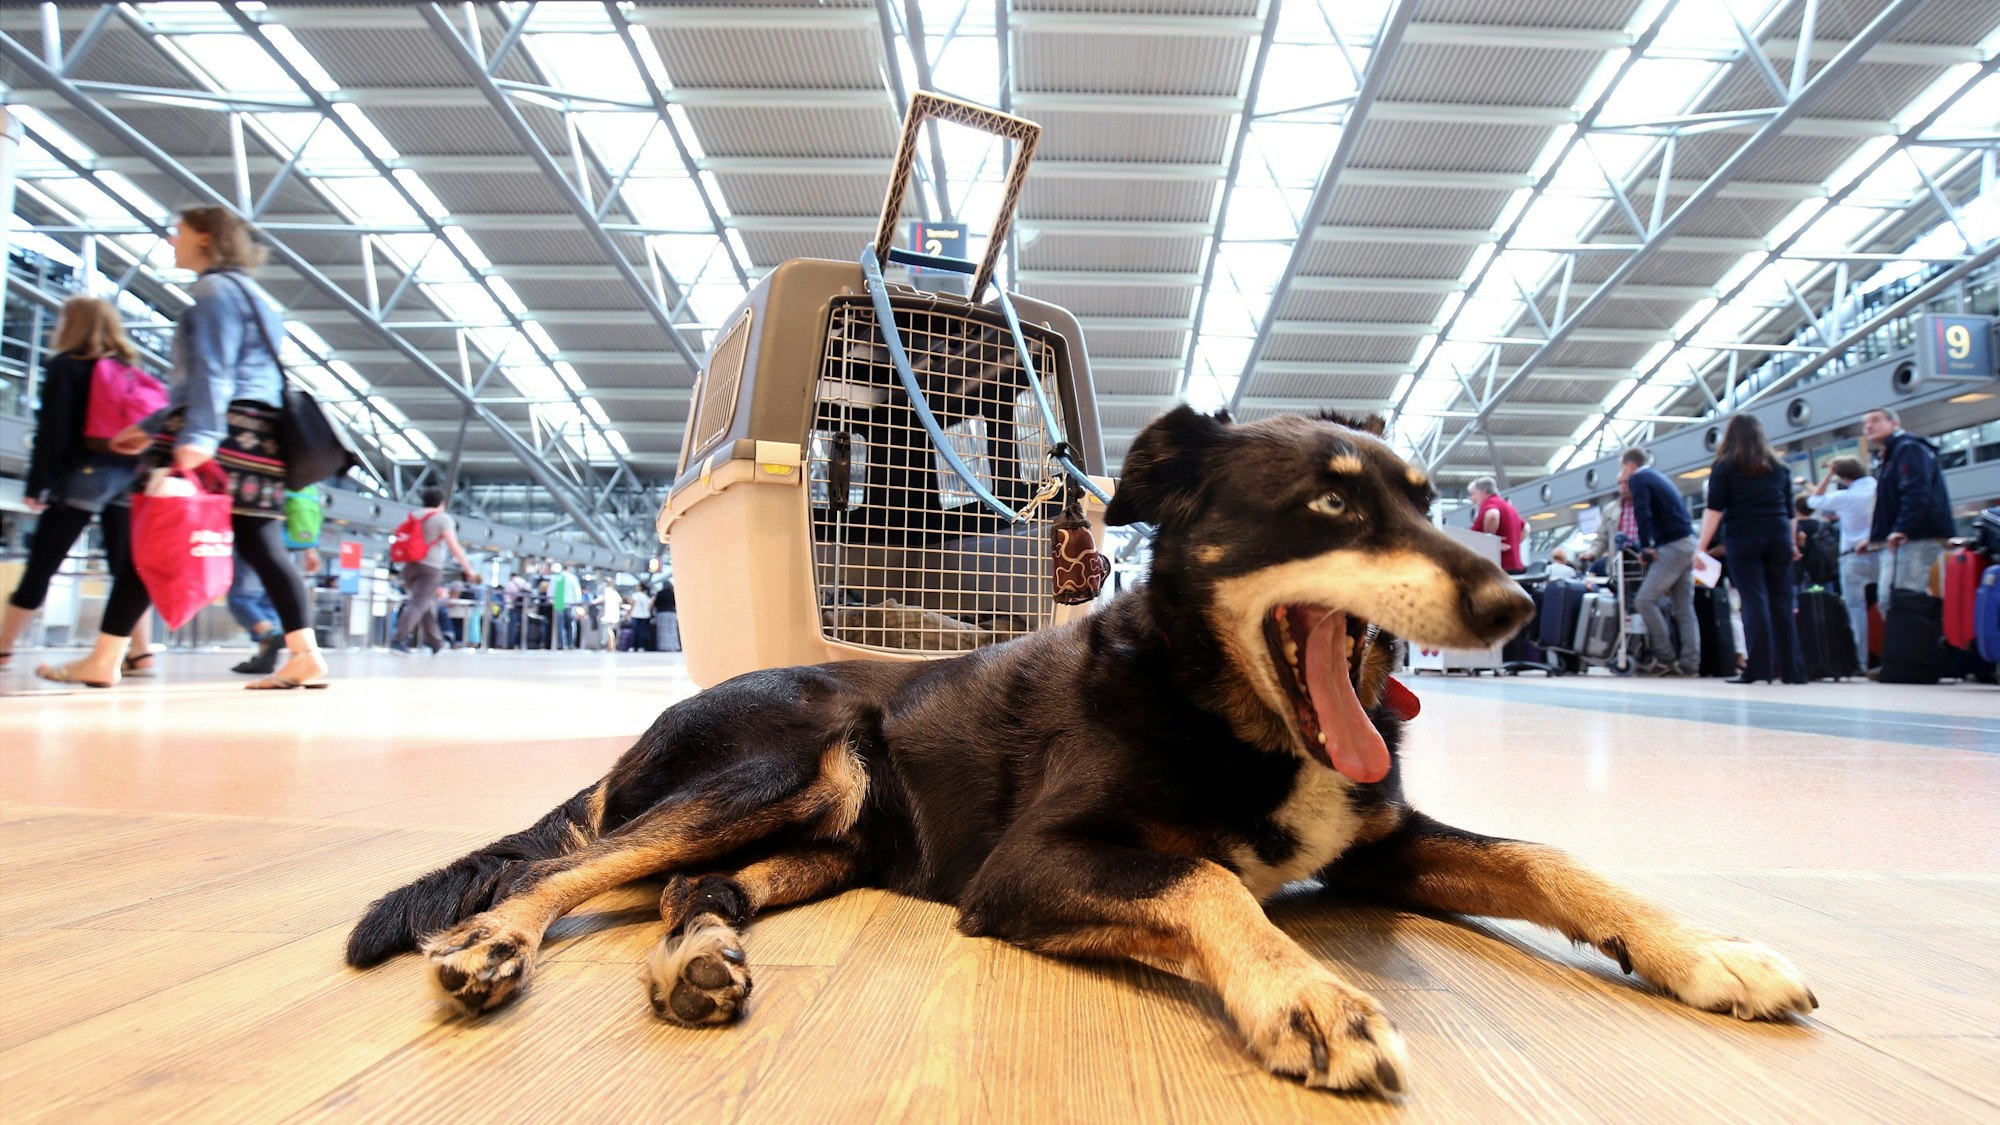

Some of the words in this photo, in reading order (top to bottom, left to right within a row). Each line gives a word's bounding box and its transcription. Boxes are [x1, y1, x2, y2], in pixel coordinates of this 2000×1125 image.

[926, 228, 959, 239] Terminal
[925, 239, 942, 257] 2
[1946, 324, 1970, 359] 9
